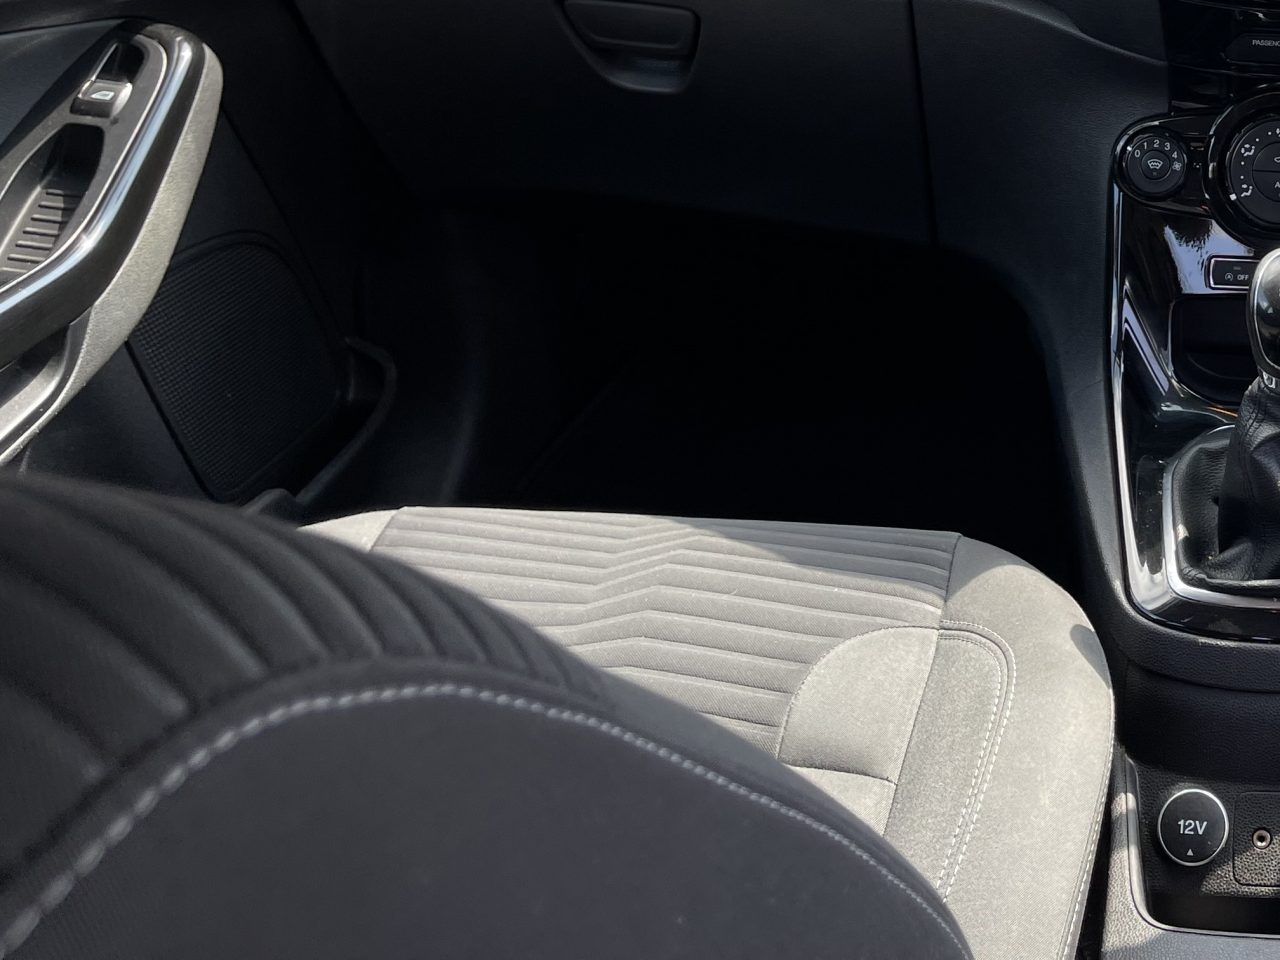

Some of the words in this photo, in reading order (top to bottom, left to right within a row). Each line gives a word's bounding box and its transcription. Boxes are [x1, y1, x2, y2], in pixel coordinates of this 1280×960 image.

[1153, 139, 1160, 148] 2
[1164, 142, 1170, 151] 3
[1134, 149, 1141, 158] 0
[1172, 151, 1178, 159] 4
[1177, 819, 1208, 836] 12V
